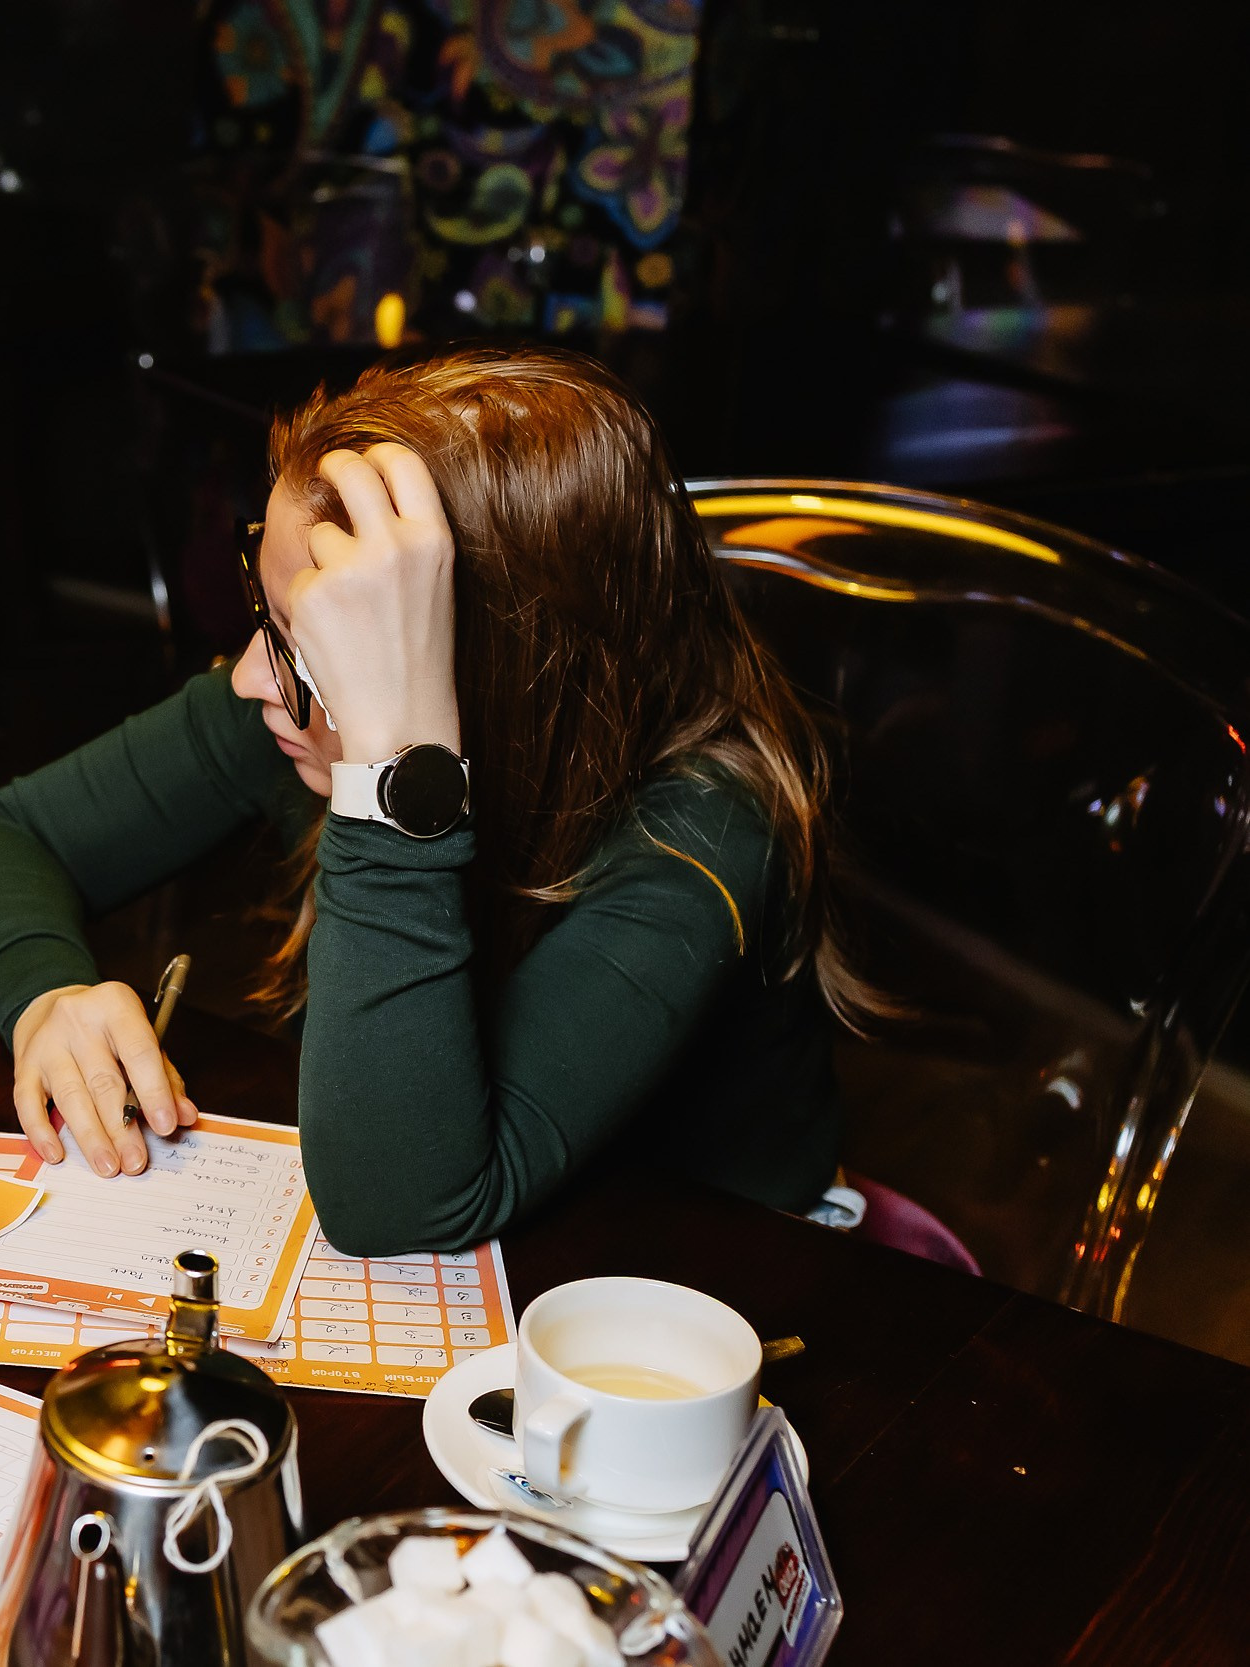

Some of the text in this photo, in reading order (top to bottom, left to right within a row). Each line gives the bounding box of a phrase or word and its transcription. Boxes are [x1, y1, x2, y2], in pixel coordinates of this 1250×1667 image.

[288, 1174, 297, 1183] 9
[283, 1188, 294, 1197] 8
[272, 1215, 283, 1223] 6
[266, 1229, 277, 1237] 5
[261, 1242, 271, 1250] 4
[141, 1255, 174, 1265] skin
[255, 1257, 266, 1266] 3
[110, 1267, 144, 1280] Park
[249, 1274, 259, 1282] 2
[455, 1273, 466, 1282] 5
[241, 1290, 251, 1300] 1
[461, 1312, 472, 1322] 3
[10, 1348, 61, 1358] ШЕСТОЙ
[311, 1369, 361, 1379] ВТОРОЙ
[384, 1374, 439, 1383] ПЕРВЫЙ
